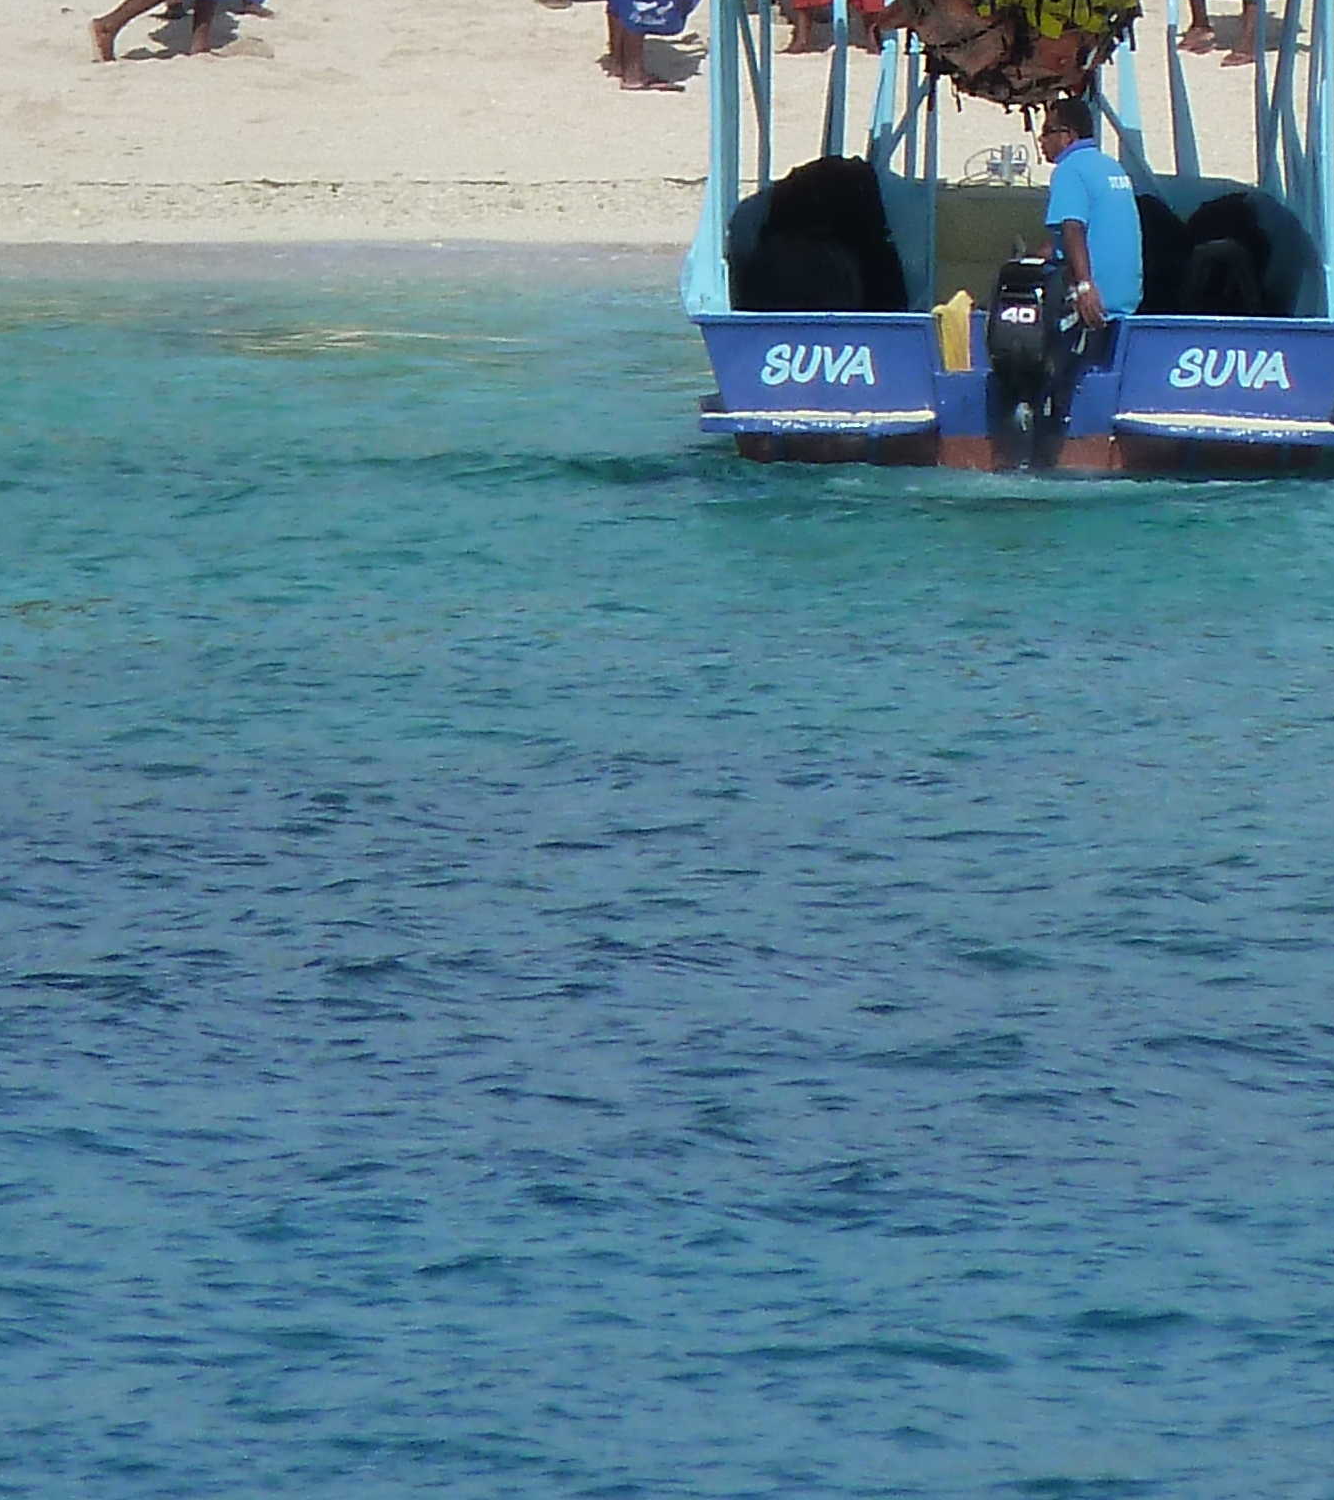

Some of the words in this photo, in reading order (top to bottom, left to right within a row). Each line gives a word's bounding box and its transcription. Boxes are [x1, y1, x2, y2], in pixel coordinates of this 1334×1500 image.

[1000, 306, 1036, 324] 40
[760, 343, 876, 386] SUVA
[1169, 347, 1290, 390] SUVA
